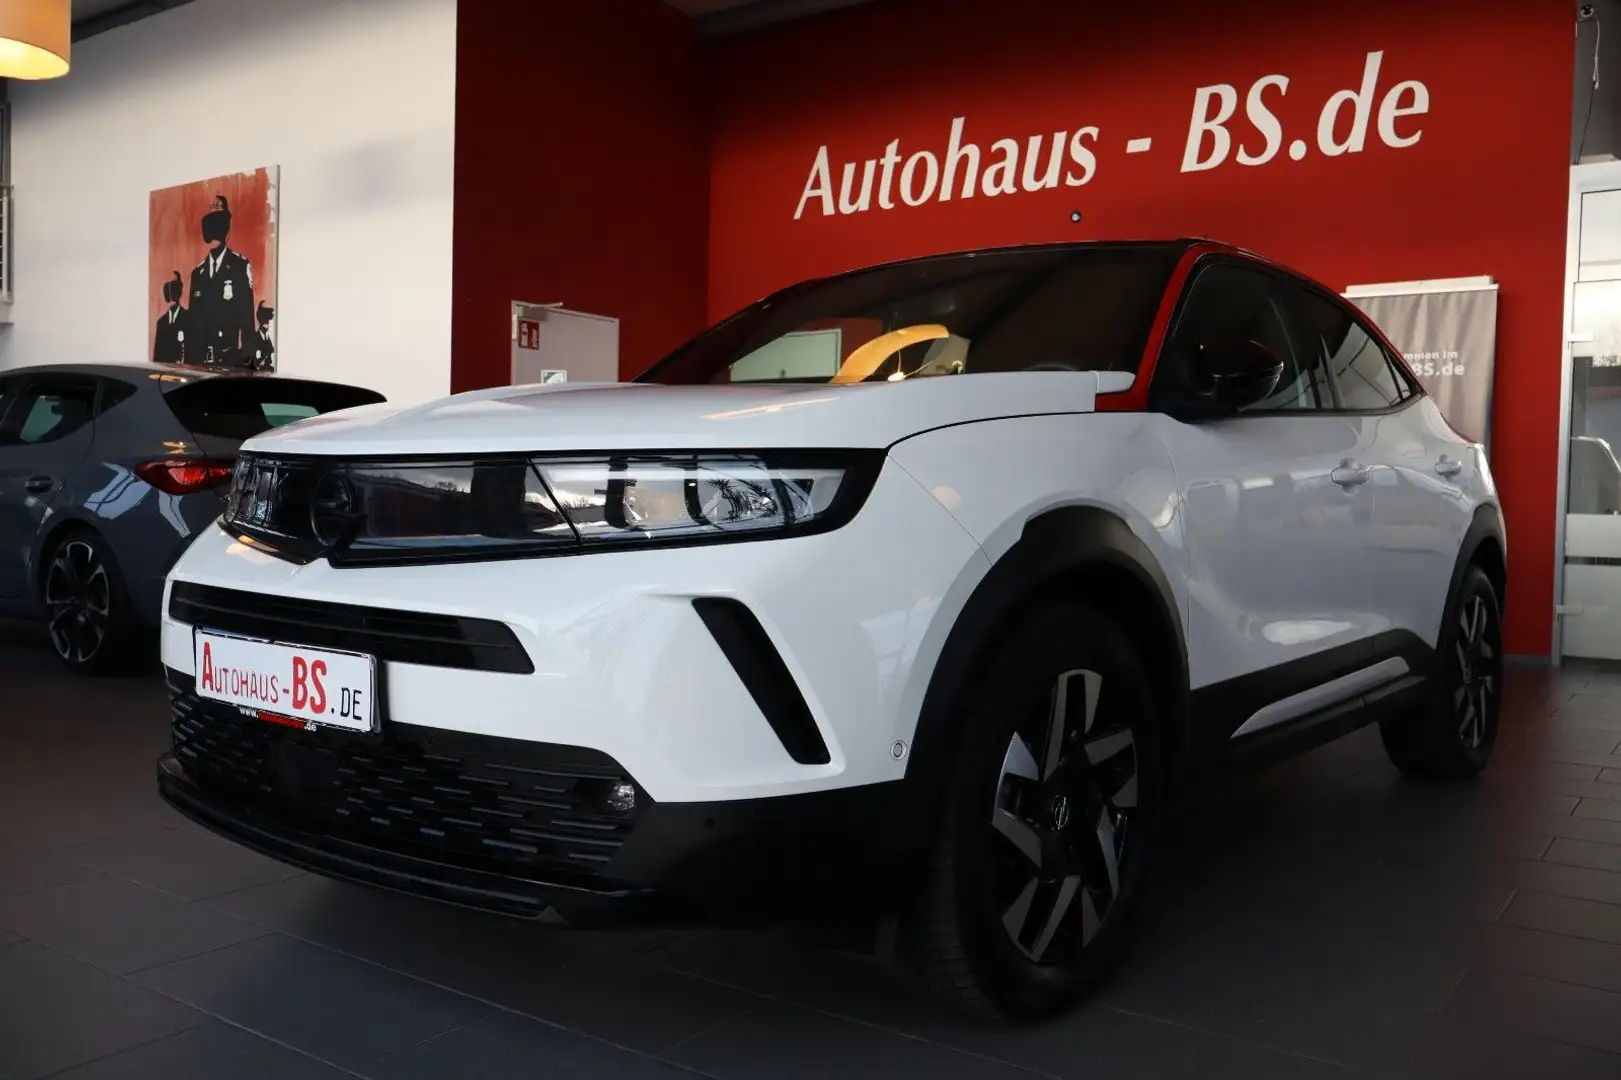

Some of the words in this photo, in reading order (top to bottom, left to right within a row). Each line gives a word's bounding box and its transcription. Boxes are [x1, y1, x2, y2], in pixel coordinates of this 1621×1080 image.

[793, 116, 1100, 220] Autohaus
[1125, 136, 1152, 155] -
[1180, 50, 1430, 174] BS.de
